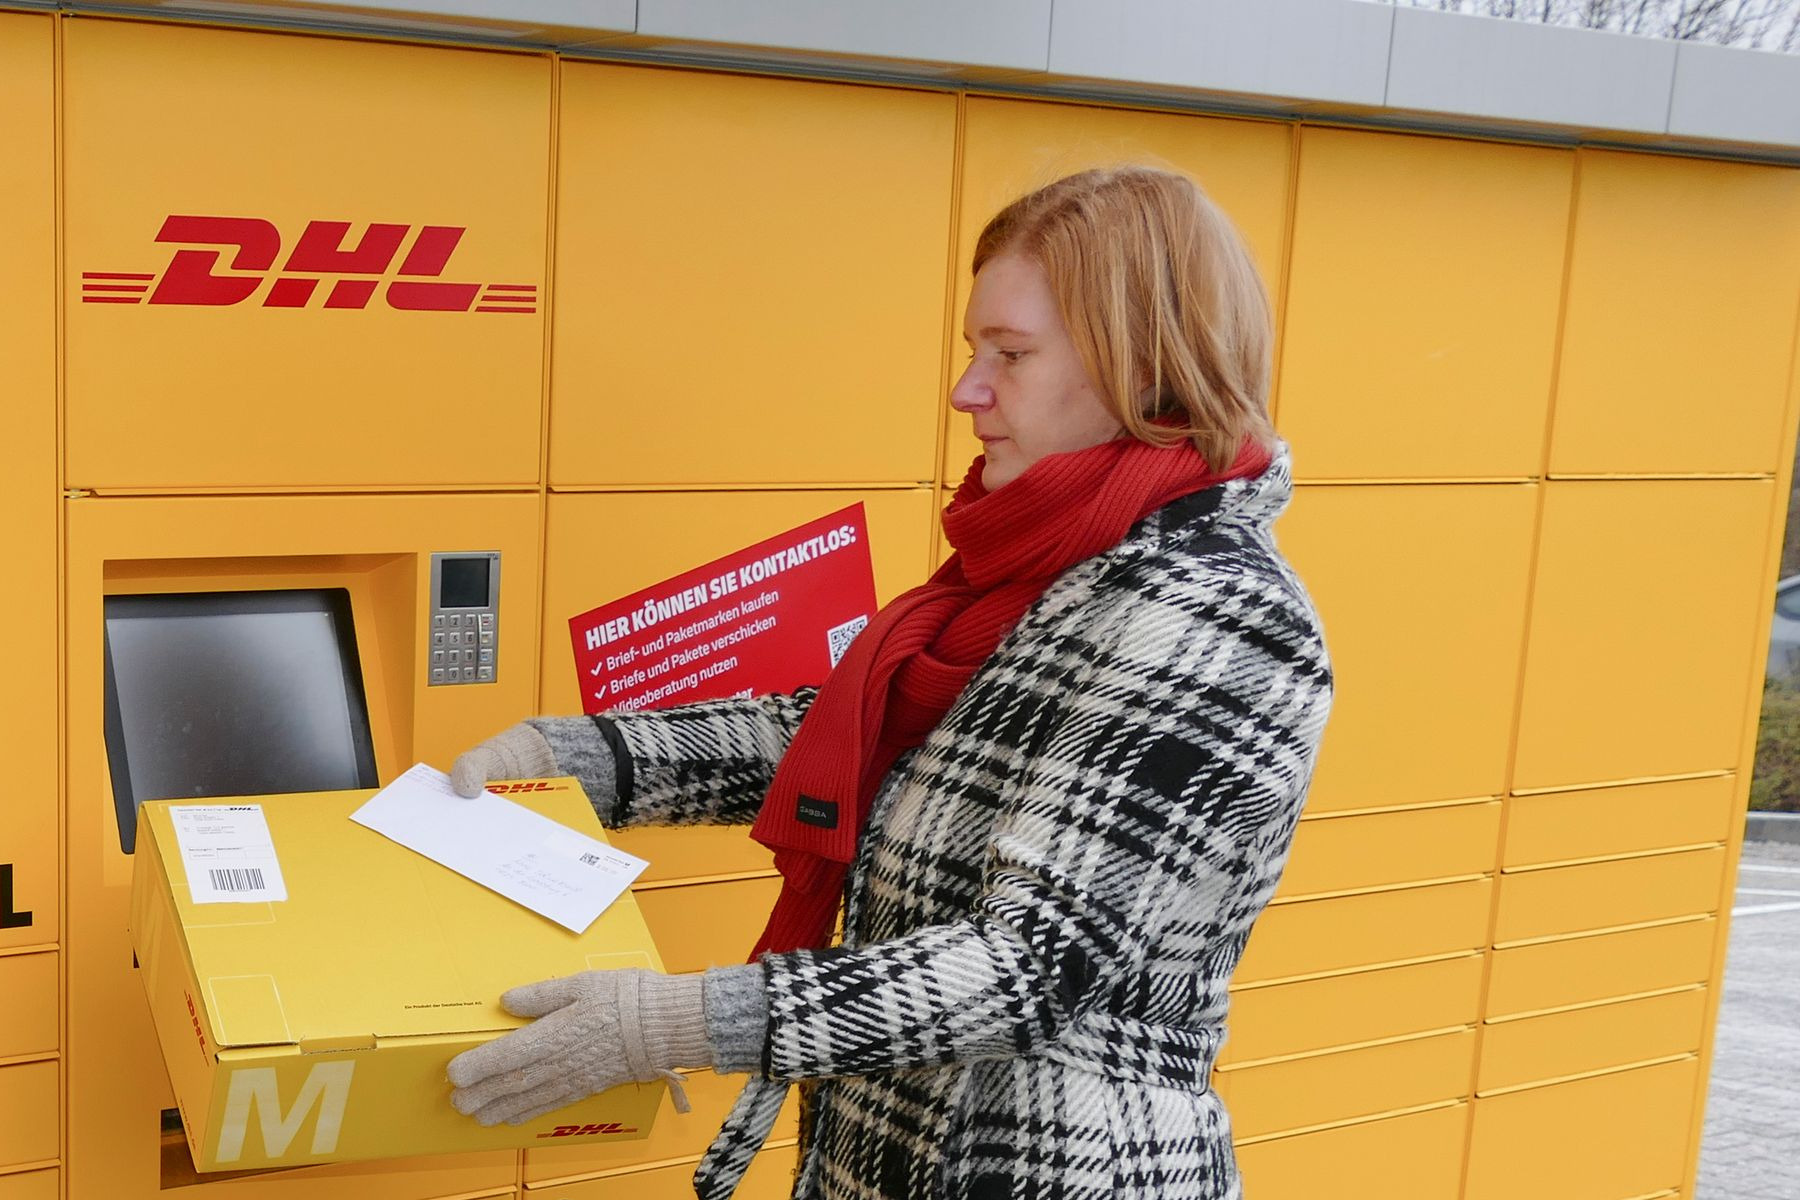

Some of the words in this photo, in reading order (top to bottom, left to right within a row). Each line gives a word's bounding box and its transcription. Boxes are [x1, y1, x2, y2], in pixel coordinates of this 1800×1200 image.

[147, 214, 483, 313] DHL
[585, 616, 631, 650] HIER
[631, 599, 709, 632] KÖNNEN
[709, 571, 739, 600] SIE
[739, 524, 857, 588] KONTAKTLOS:
[606, 650, 639, 671] Brief-
[641, 636, 664, 656] und
[665, 606, 740, 647] Paketmarken
[741, 590, 780, 617] kaufen
[610, 669, 646, 694] Briefe
[647, 658, 670, 679] und
[671, 643, 711, 669] Pakete
[711, 615, 777, 651] verschicken
[699, 655, 738, 682] nutzen
[484, 782, 555, 795] DHL
[186, 992, 206, 1057] DHL
[215, 1059, 357, 1164] M
[550, 1122, 624, 1138] DHL
